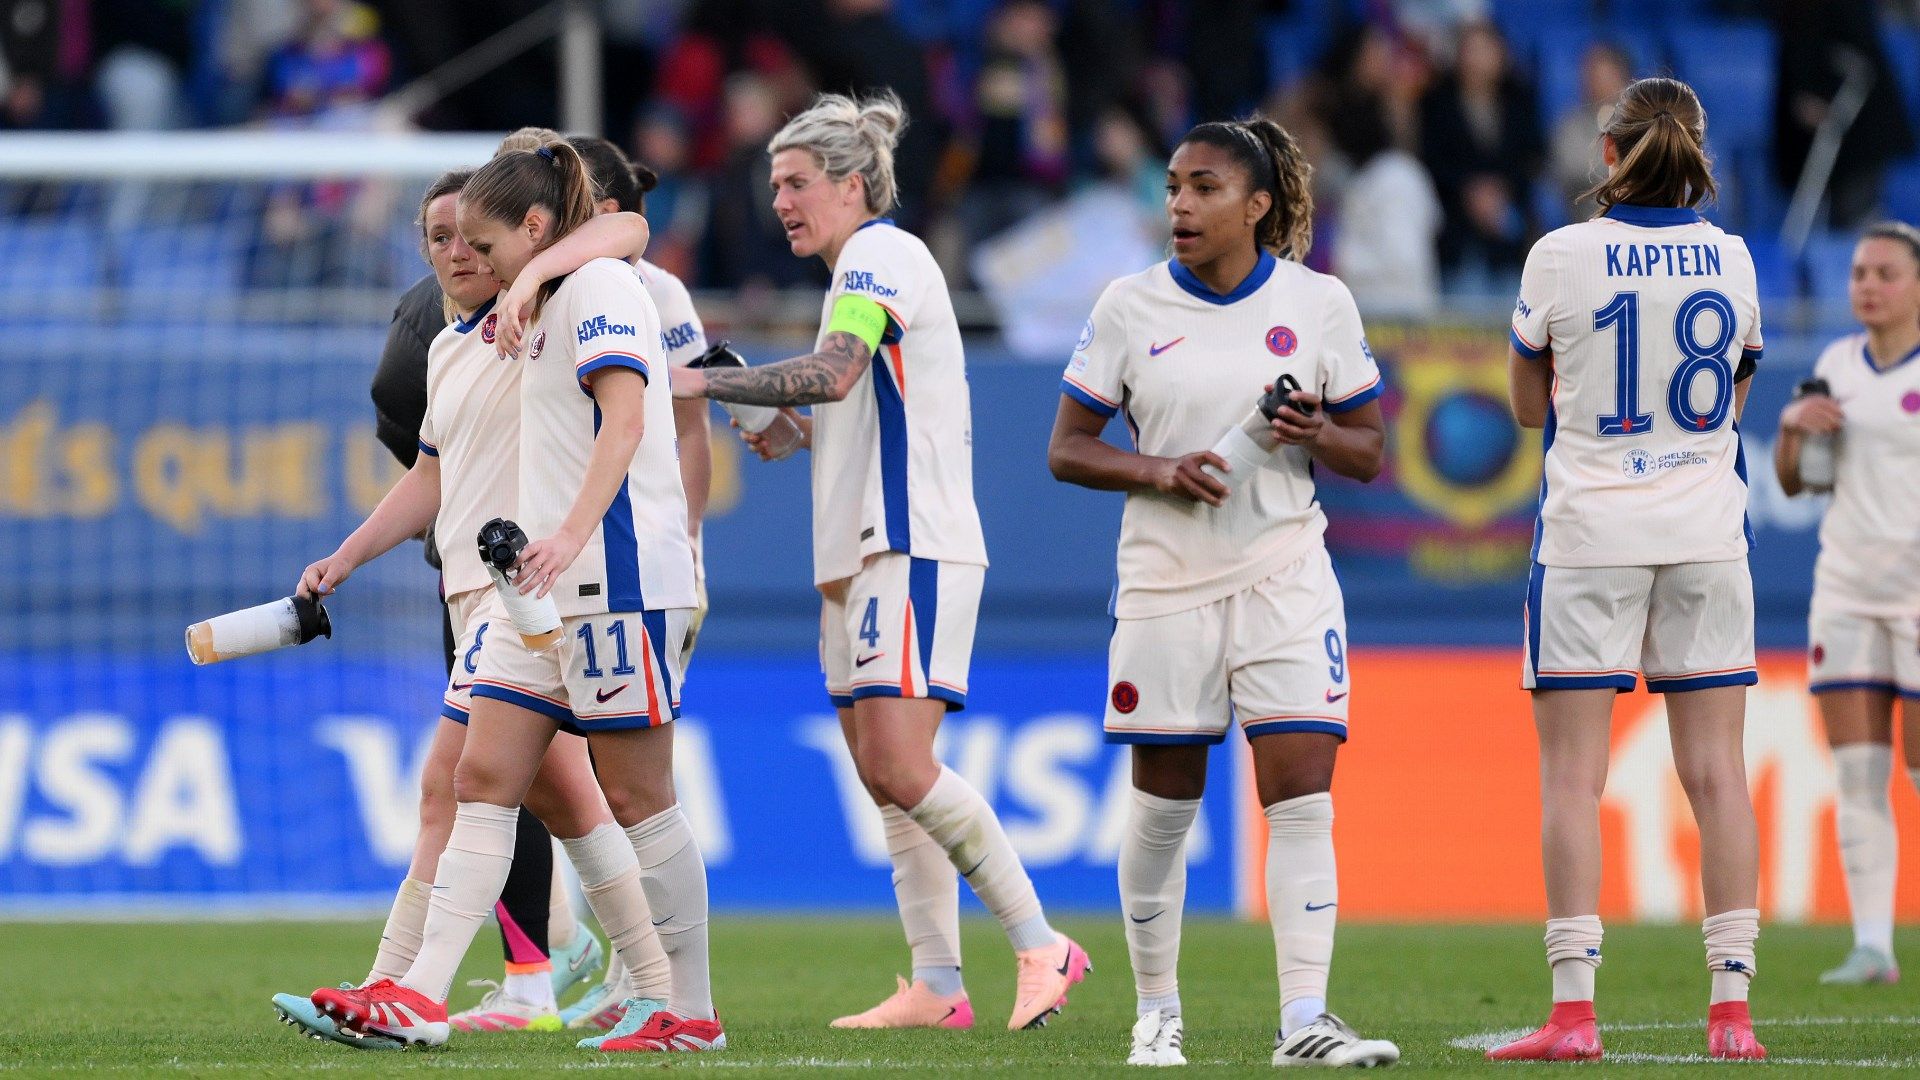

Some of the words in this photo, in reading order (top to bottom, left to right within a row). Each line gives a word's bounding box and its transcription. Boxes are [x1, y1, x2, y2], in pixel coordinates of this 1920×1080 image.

[844, 270, 874, 282] LIVE
[1605, 244, 1722, 277] KAPTEIN
[844, 280, 898, 297] NATION
[577, 314, 607, 334] LIVE
[578, 324, 636, 345] NATION
[1592, 288, 1738, 437] 18
[132, 420, 329, 533] QUE
[859, 596, 880, 648] 4
[576, 619, 636, 679] 11
[1324, 628, 1344, 684] 9
